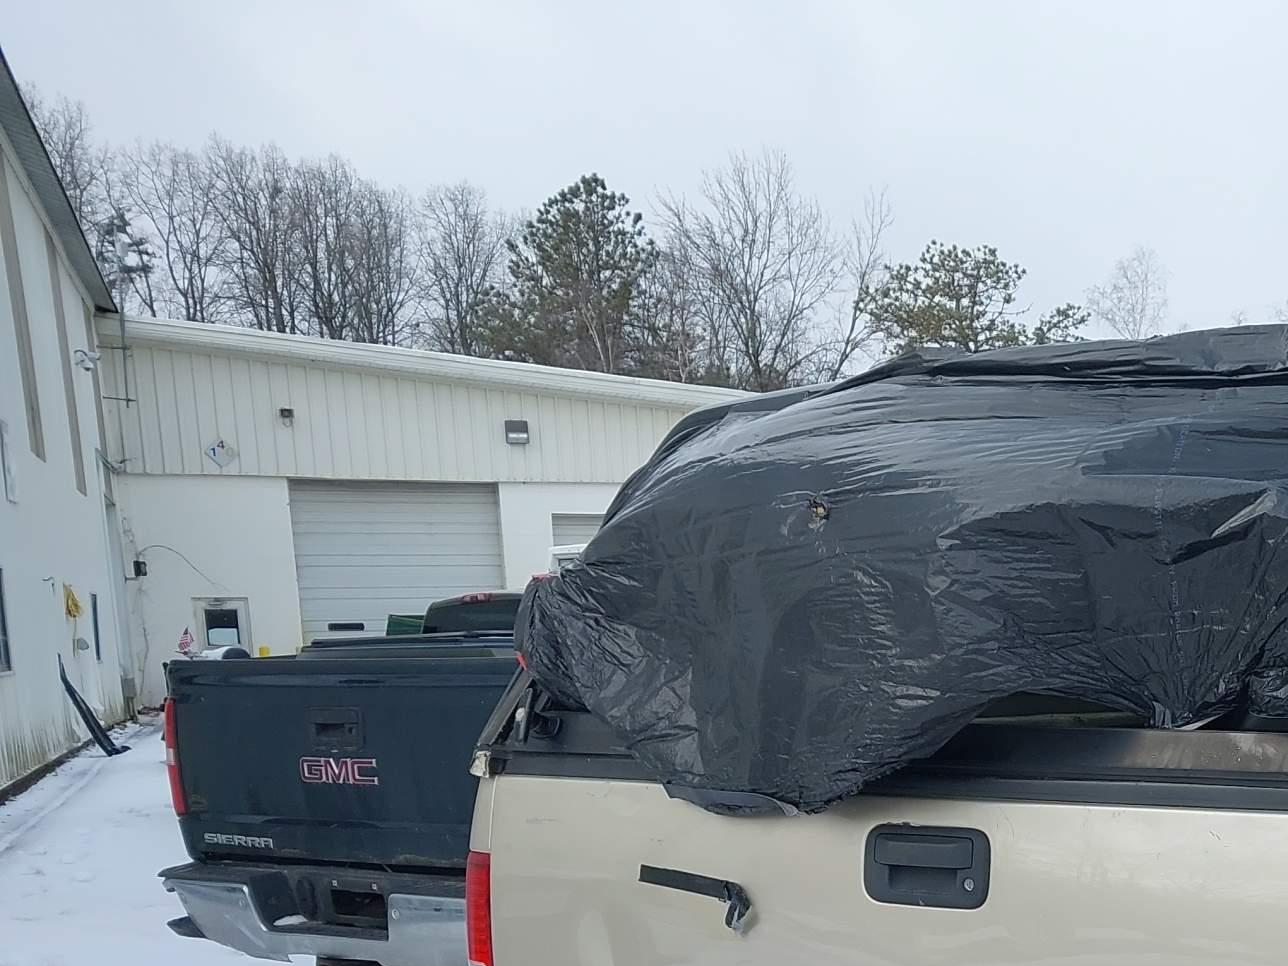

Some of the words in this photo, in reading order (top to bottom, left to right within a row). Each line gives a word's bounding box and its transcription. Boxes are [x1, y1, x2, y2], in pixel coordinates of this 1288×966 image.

[216, 439, 225, 450] 4
[209, 447, 216, 457] 1
[300, 756, 379, 786] GMC
[203, 832, 274, 849] SIERRA
